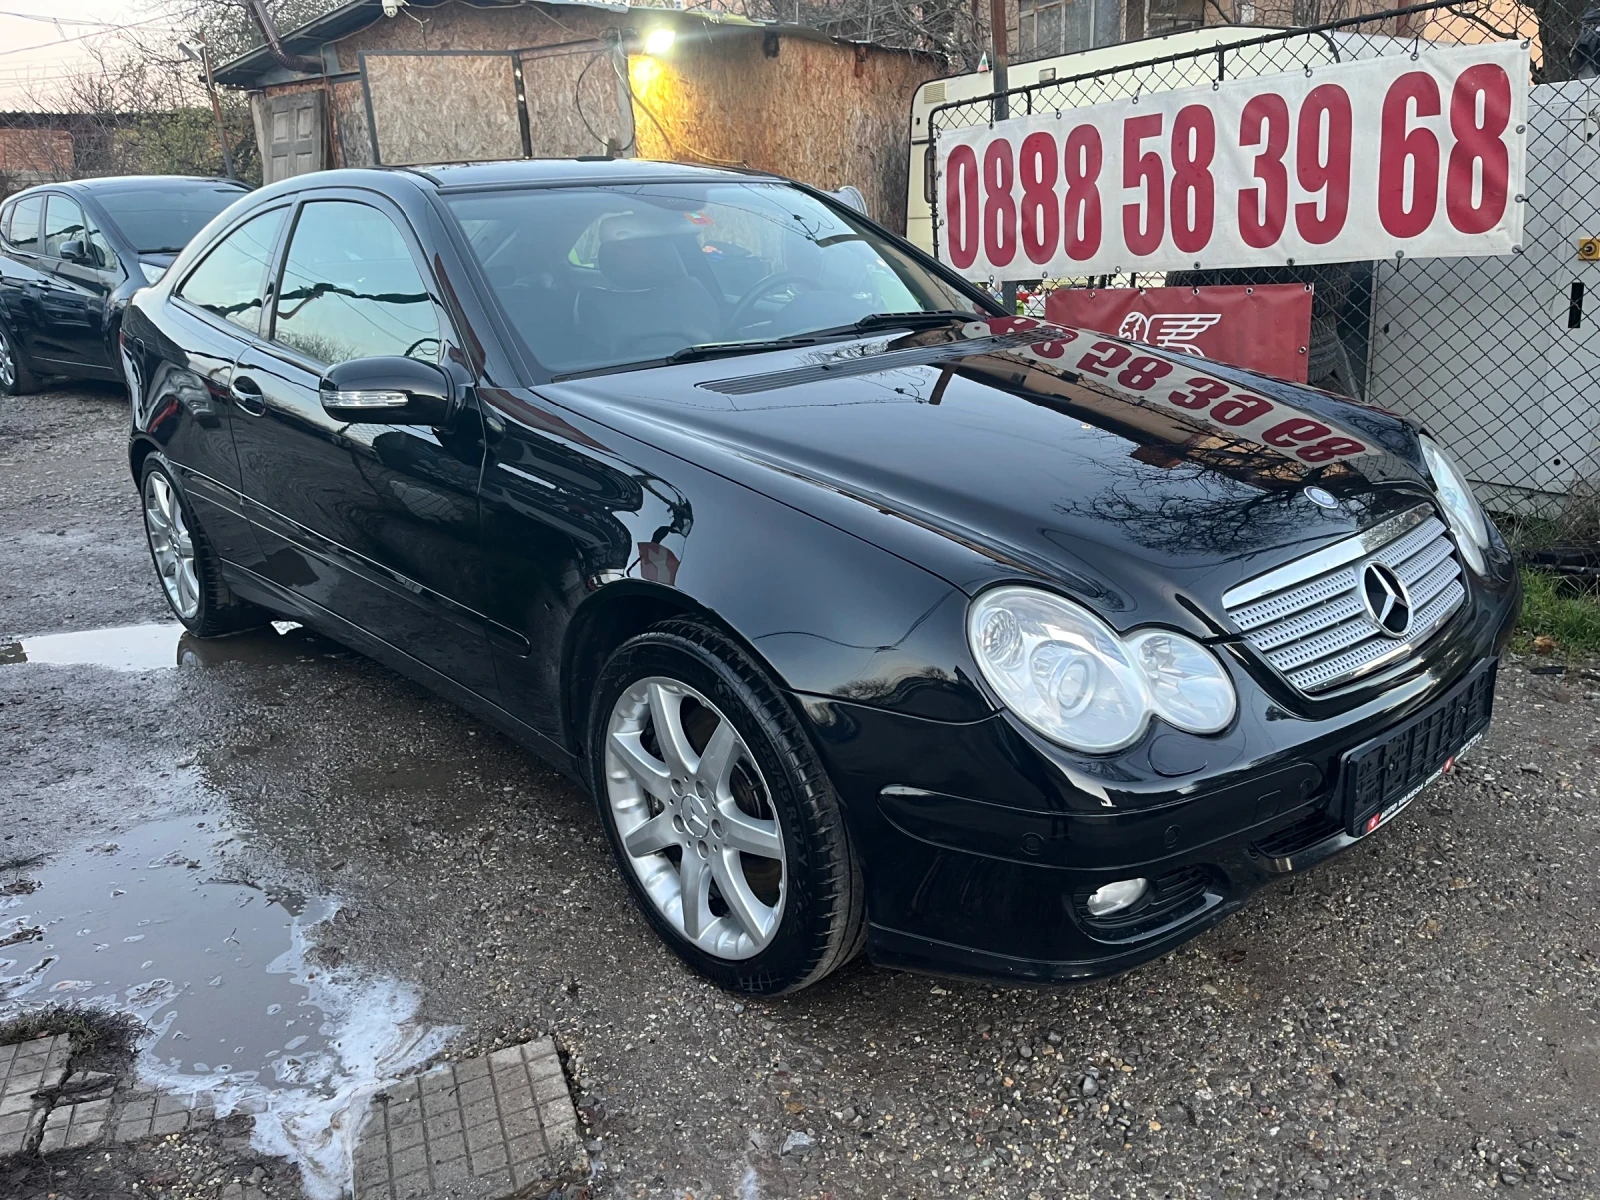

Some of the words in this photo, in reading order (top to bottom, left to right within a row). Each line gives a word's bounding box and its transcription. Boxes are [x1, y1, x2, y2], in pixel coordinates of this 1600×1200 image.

[947, 124, 1103, 269] 0888
[1122, 104, 1216, 256] 58
[1238, 84, 1353, 249] 39
[1378, 63, 1511, 238] 68
